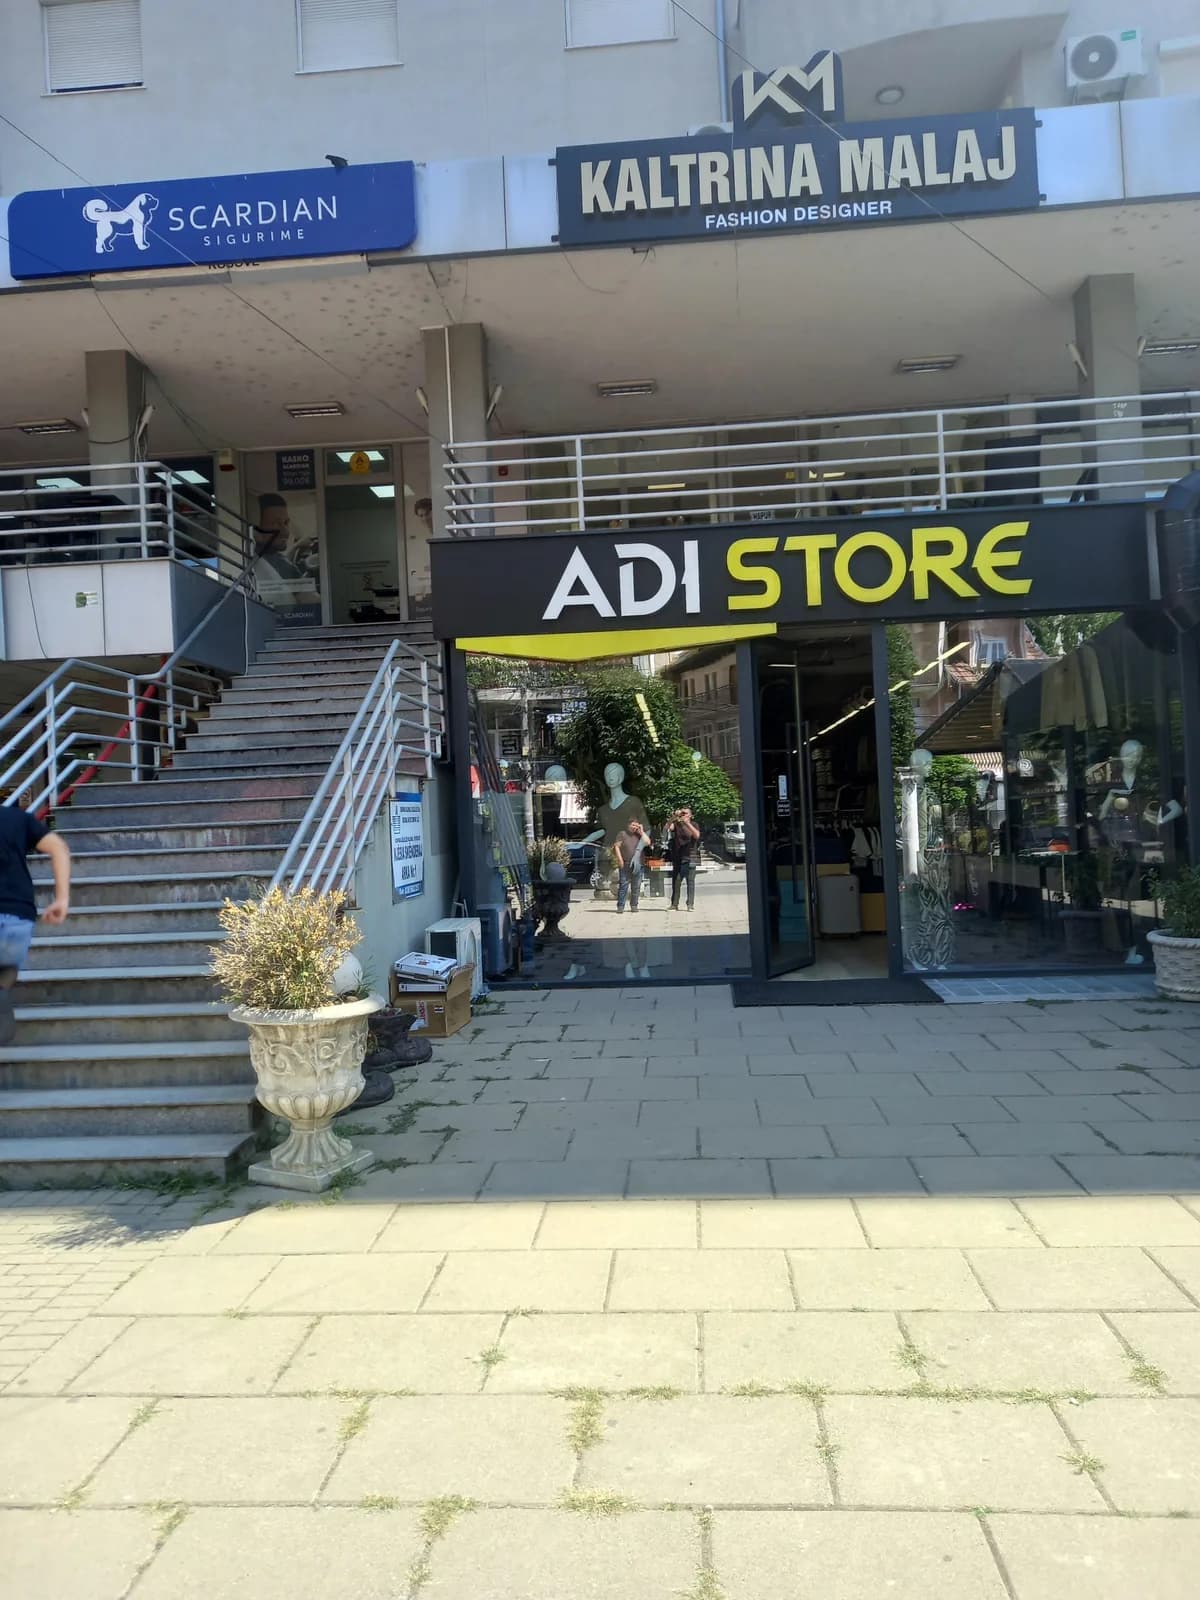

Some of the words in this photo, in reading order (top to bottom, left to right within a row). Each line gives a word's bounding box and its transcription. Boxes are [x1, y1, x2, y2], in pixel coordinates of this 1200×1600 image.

[580, 143, 822, 214] KALTRINA
[839, 126, 1016, 194] MALAJ
[168, 196, 337, 232] SCARDIAN
[705, 210, 786, 229] FASHION
[794, 201, 892, 222] DESIGNER
[203, 229, 305, 246] SIGURIME
[542, 540, 701, 621] ADI
[726, 521, 1033, 611] STORE
